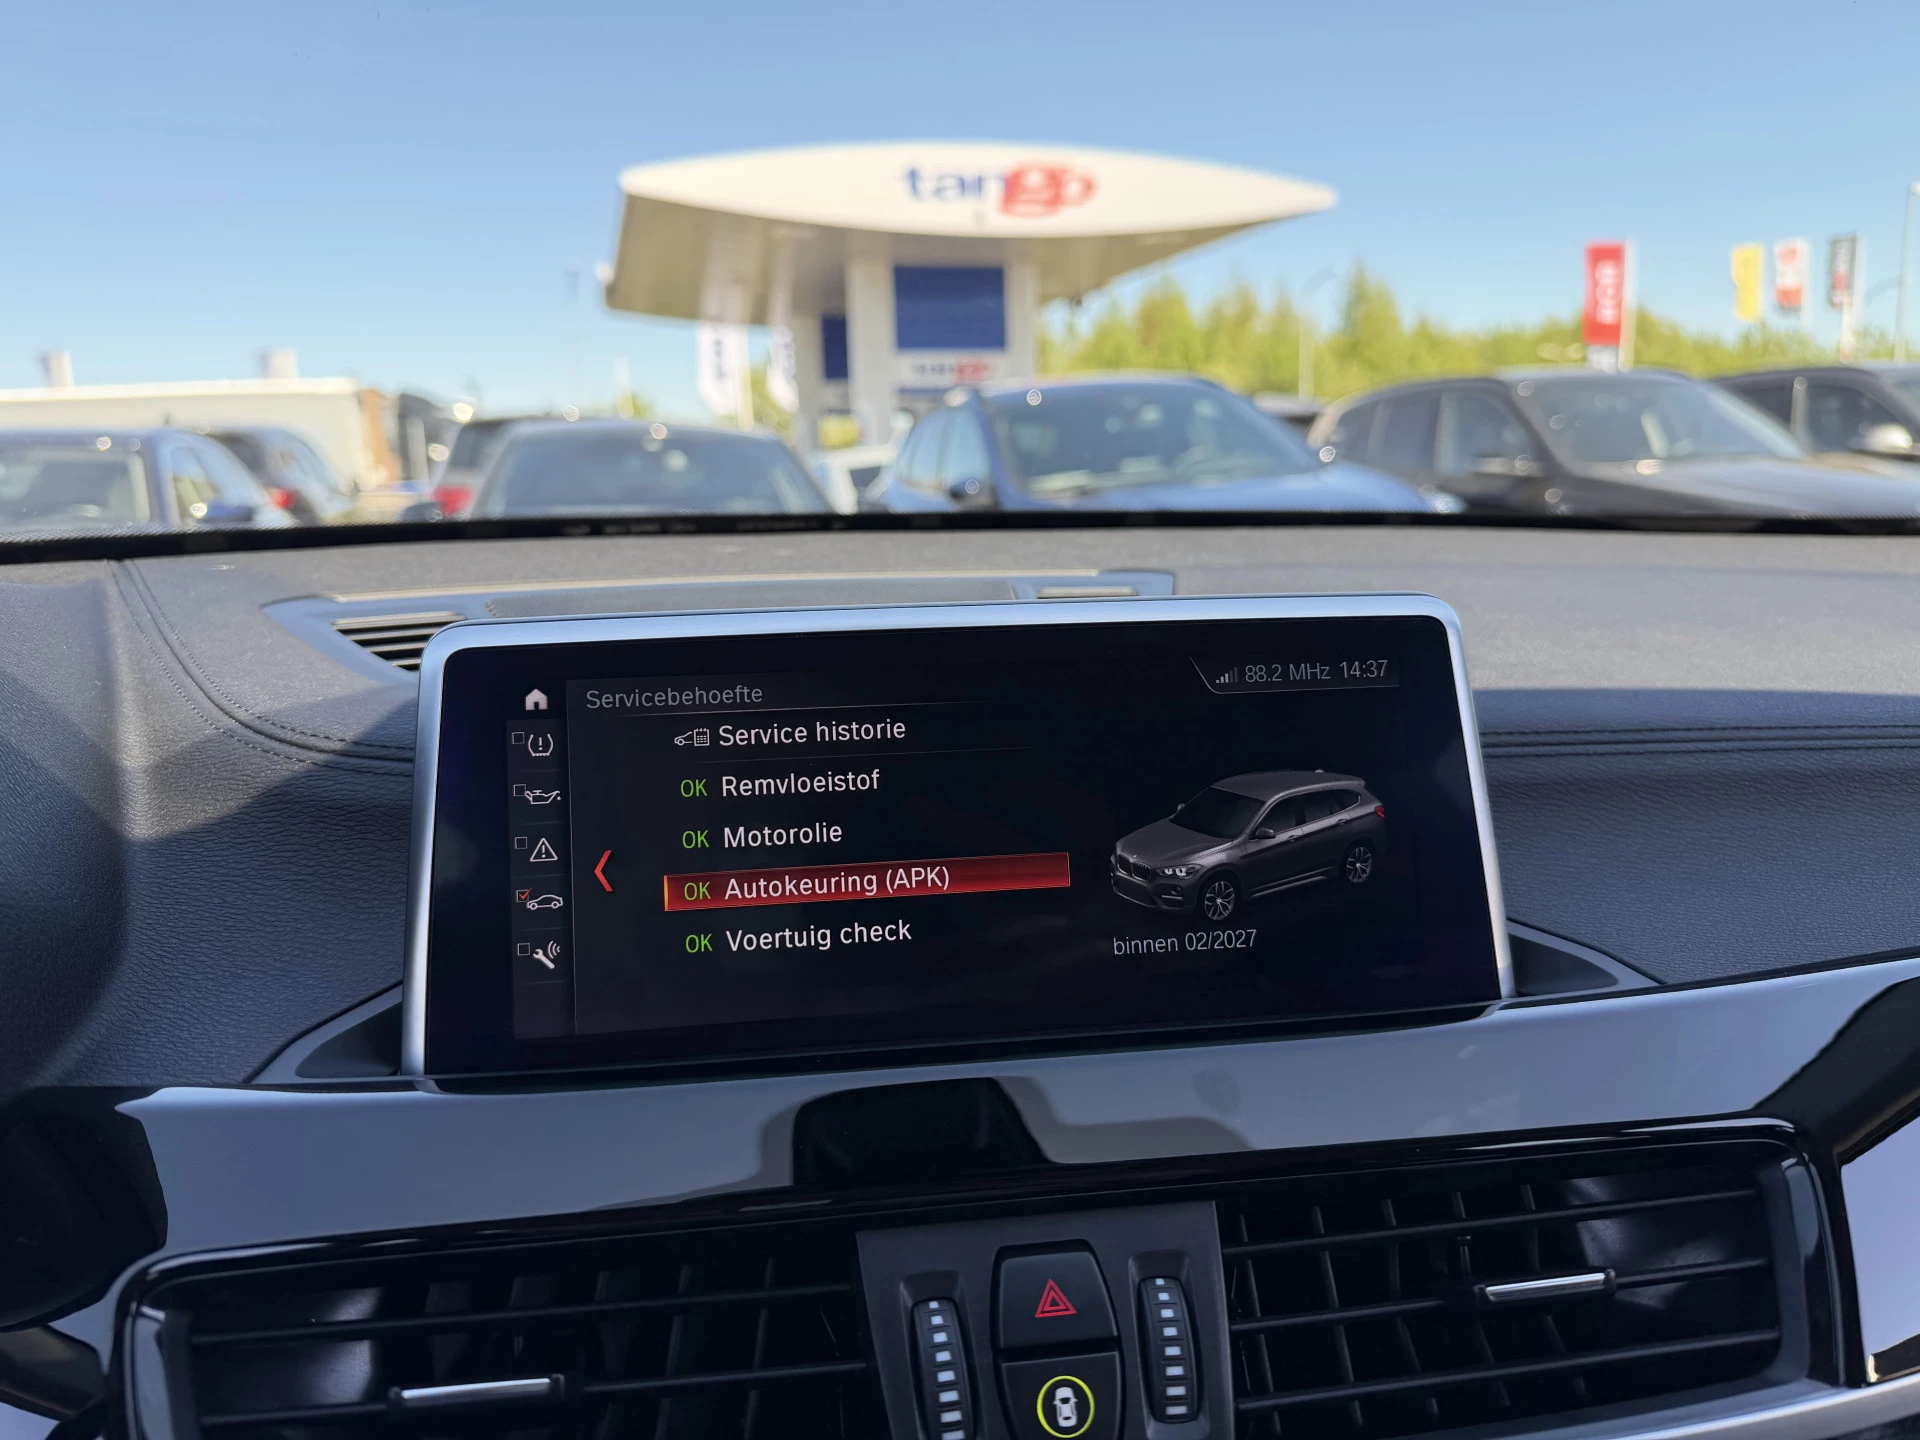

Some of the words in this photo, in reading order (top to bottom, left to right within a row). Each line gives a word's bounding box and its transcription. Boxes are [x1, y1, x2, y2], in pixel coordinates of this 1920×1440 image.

[1244, 663, 1283, 683] 88.2
[1289, 662, 1331, 681] MHz
[1339, 659, 1389, 679] 14:37
[585, 684, 764, 711] Servicebehoefte
[718, 723, 808, 746] Service
[815, 718, 907, 742] historie
[680, 778, 708, 798] OK
[721, 768, 880, 797] Remvloeistof
[682, 829, 710, 849] OK
[723, 821, 843, 849] Motorolie
[684, 881, 711, 901] OK
[724, 871, 877, 901] Autokeuring
[885, 866, 950, 894] (APK)
[685, 933, 713, 953] OK
[725, 924, 831, 952] Voertuig
[839, 919, 912, 944] check
[1113, 936, 1179, 956] binnen
[1185, 929, 1257, 951] 02/2027
